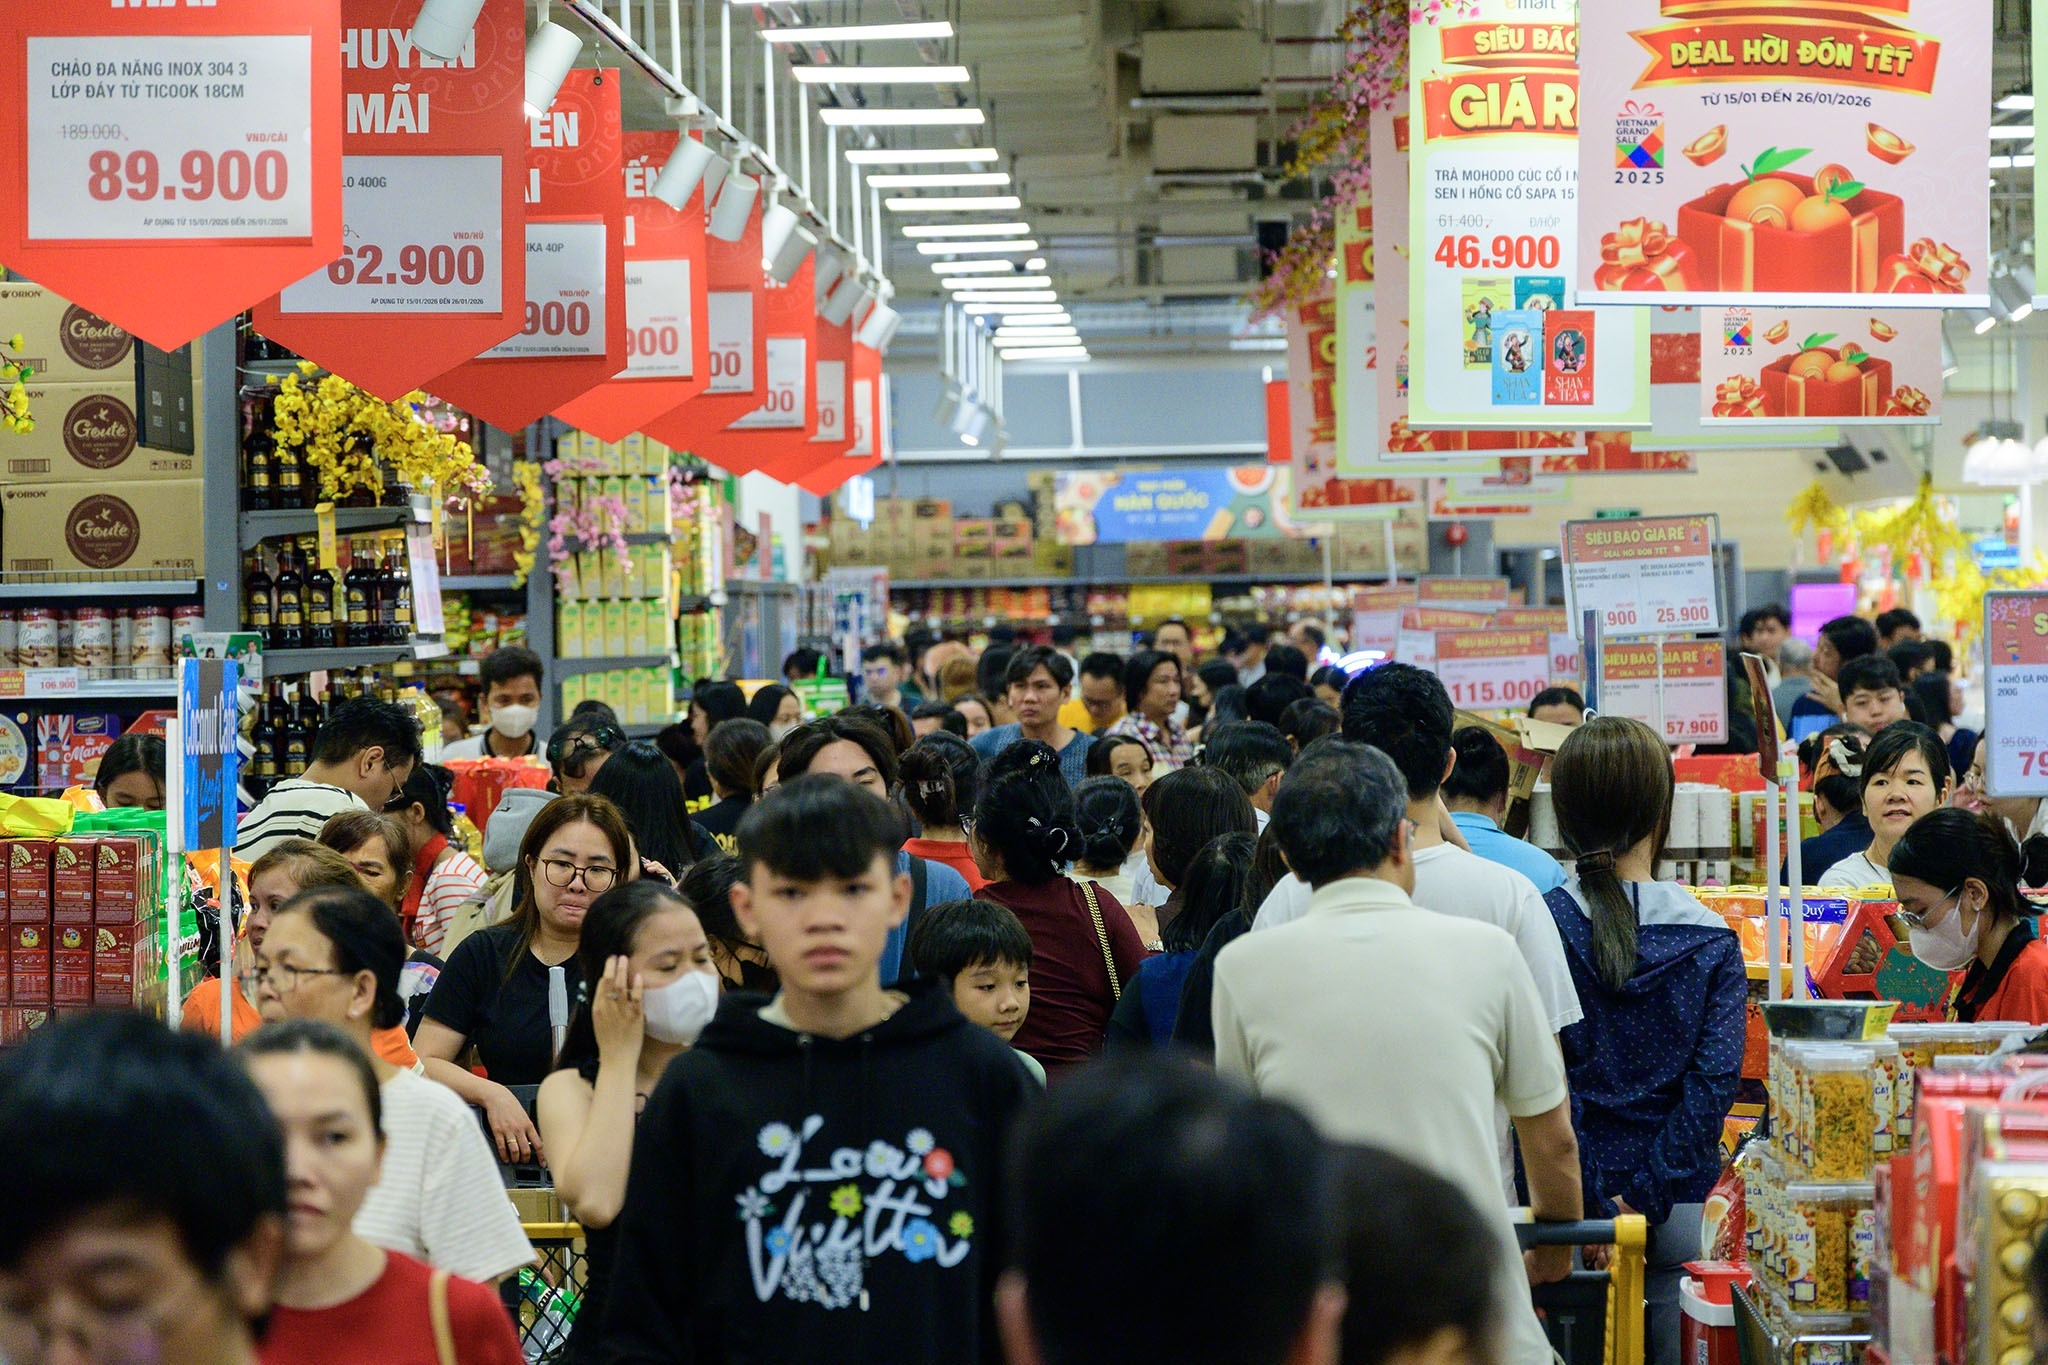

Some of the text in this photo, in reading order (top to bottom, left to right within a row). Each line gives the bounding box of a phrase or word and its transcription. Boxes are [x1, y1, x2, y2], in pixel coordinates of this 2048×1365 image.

[1474, 24, 1525, 54] SIÊU
[1670, 32, 1914, 78] DEAL HỜI ĐÓN TẾT
[51, 58, 248, 76] CHẢO ĐA NĂNG INOX 304 3
[51, 80, 244, 98] LỚP ĐÁY TỪ TICOOK 18CM
[1449, 76, 1537, 130] GIÁ
[1701, 88, 1873, 108] TỪ 15/01 ĐẾN 26/01/2026
[347, 83, 430, 133] MÃI
[60, 124, 121, 140] 189.000
[246, 132, 288, 143] VND/CÁI
[1616, 136, 1638, 144] SALE
[88, 149, 289, 201] 89.900
[1435, 168, 1457, 182] TRÀ
[1462, 170, 1514, 182] MOHODO
[1519, 167, 1542, 182] CÚC
[1614, 171, 1665, 184] 2025
[358, 177, 387, 188] 400G
[1435, 188, 1457, 199] SEN
[1526, 188, 1557, 199] SAPA
[1561, 188, 1575, 199] 15
[1438, 214, 1484, 228] 61.400
[547, 242, 564, 253] 40P
[1435, 235, 1560, 269] 46.900
[328, 245, 484, 285] 62.900
[11, 290, 42, 298] ORION
[521, 301, 590, 336] 900
[1723, 348, 1753, 356] 2025
[1554, 376, 1584, 389] SHAN
[1559, 389, 1580, 401] TEA
[15, 490, 48, 499] ORION
[1656, 605, 1710, 623] 25.900
[40, 681, 76, 690] 106.900
[1452, 679, 1546, 703] 115.000
[185, 690, 237, 756] Coconut Café
[1666, 720, 1718, 735] 57.900
[1801, 903, 1825, 919] Quý
[1795, 1232, 1810, 1242] CAY
